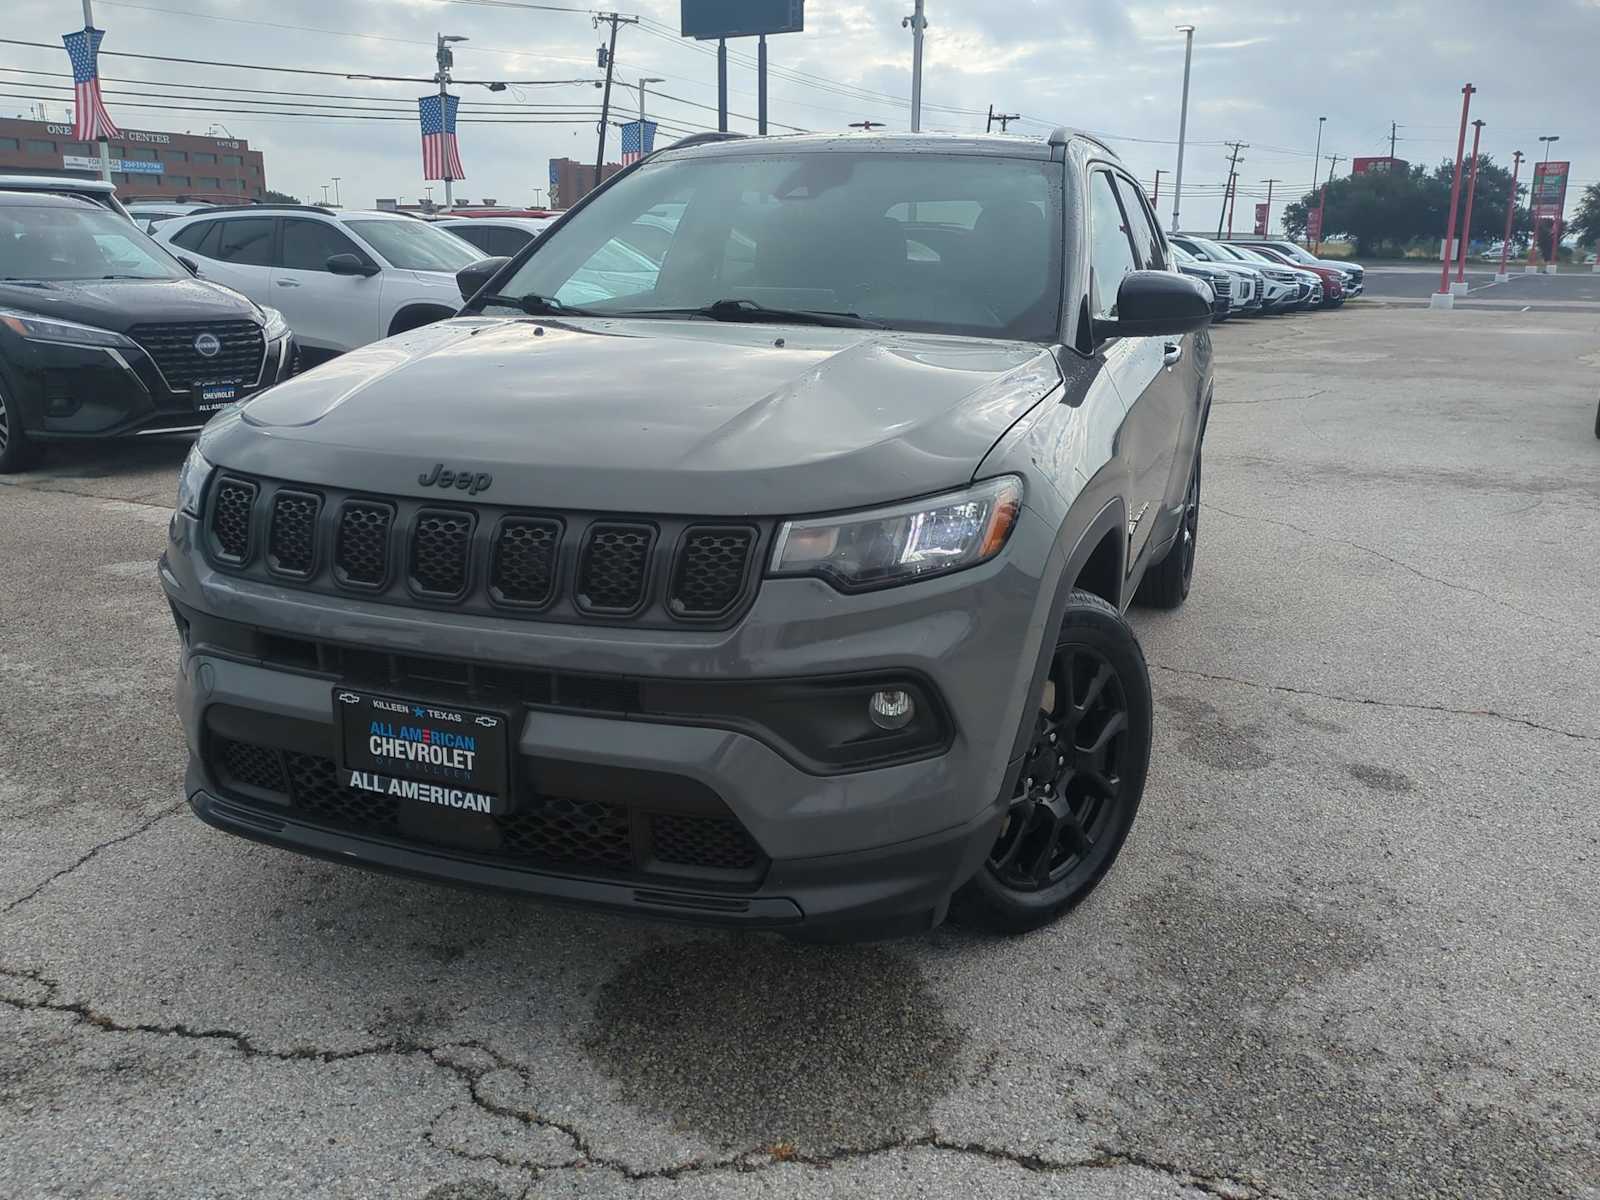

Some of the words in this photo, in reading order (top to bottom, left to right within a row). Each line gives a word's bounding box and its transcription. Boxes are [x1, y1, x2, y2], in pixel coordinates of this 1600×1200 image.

[46, 125, 72, 135] ONE
[128, 131, 170, 144] CENTER
[203, 391, 235, 400] CHEVROLET
[417, 463, 493, 496] Jeep
[372, 700, 409, 713] KILLEEN
[427, 710, 462, 723] TEXAS
[370, 721, 395, 737] ALL
[400, 726, 475, 751] AMERICAN
[369, 735, 476, 771] CHEVROLET
[350, 771, 384, 793] ALL
[388, 780, 491, 813] AMERICAN
